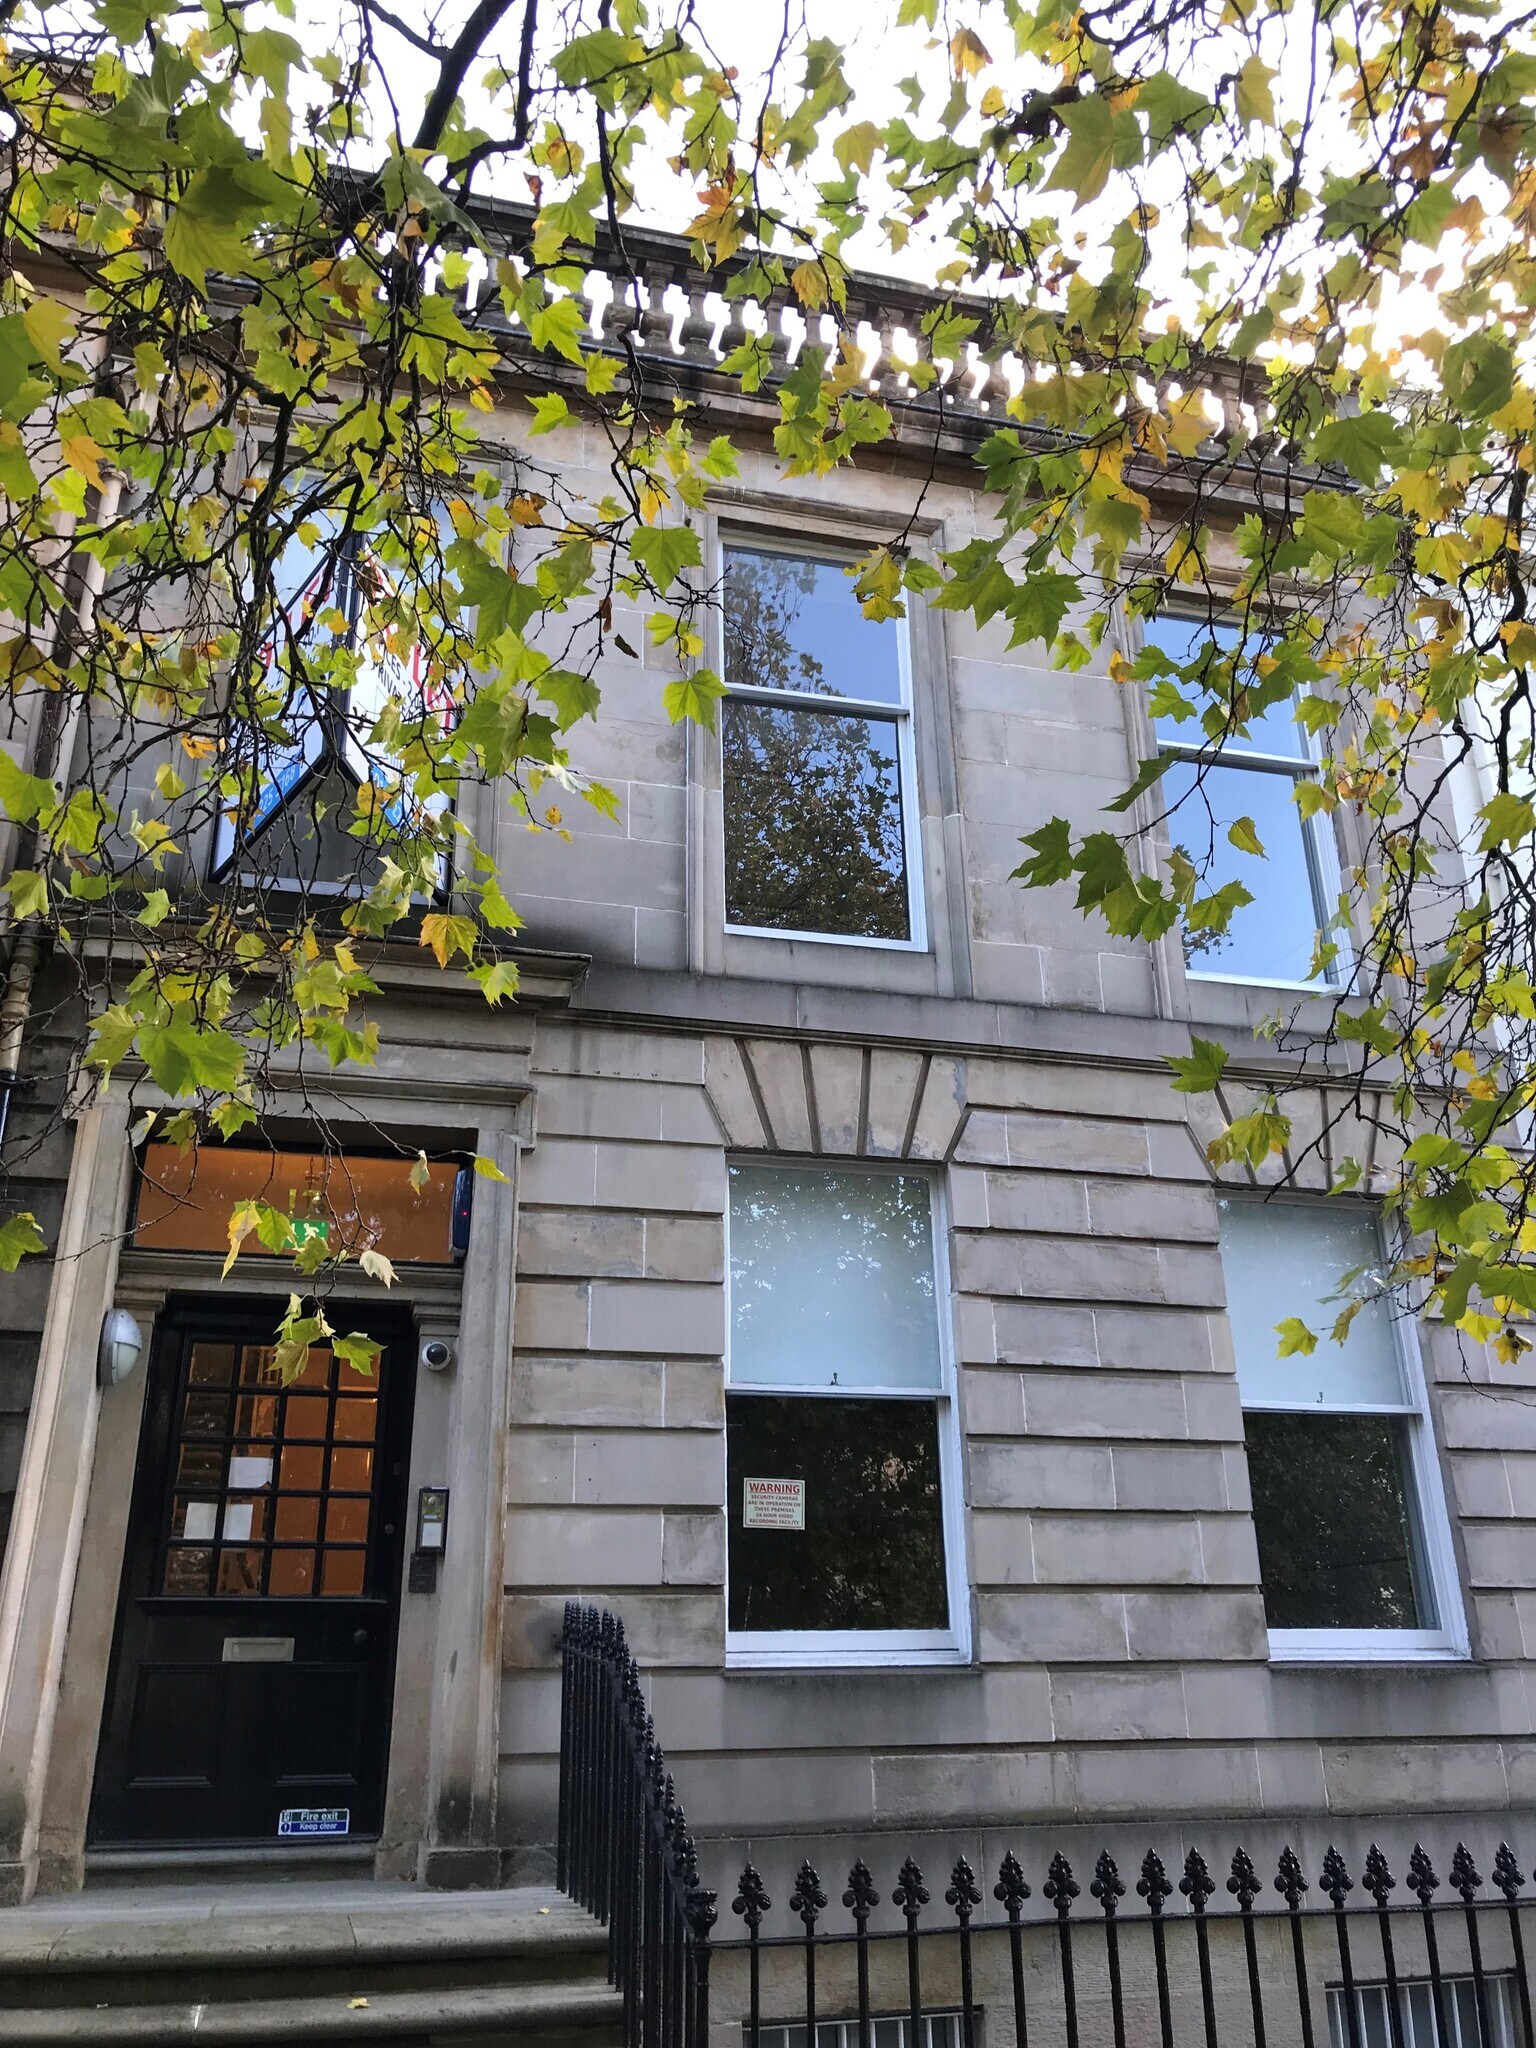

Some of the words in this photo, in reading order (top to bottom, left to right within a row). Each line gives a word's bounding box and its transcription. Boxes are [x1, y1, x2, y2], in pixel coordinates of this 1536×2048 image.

[749, 1482, 800, 1494] WARNING
[300, 1812, 319, 1821] Fire
[321, 1811, 339, 1820] exit
[300, 1823, 318, 1831] Keep
[319, 1822, 338, 1830] clear
